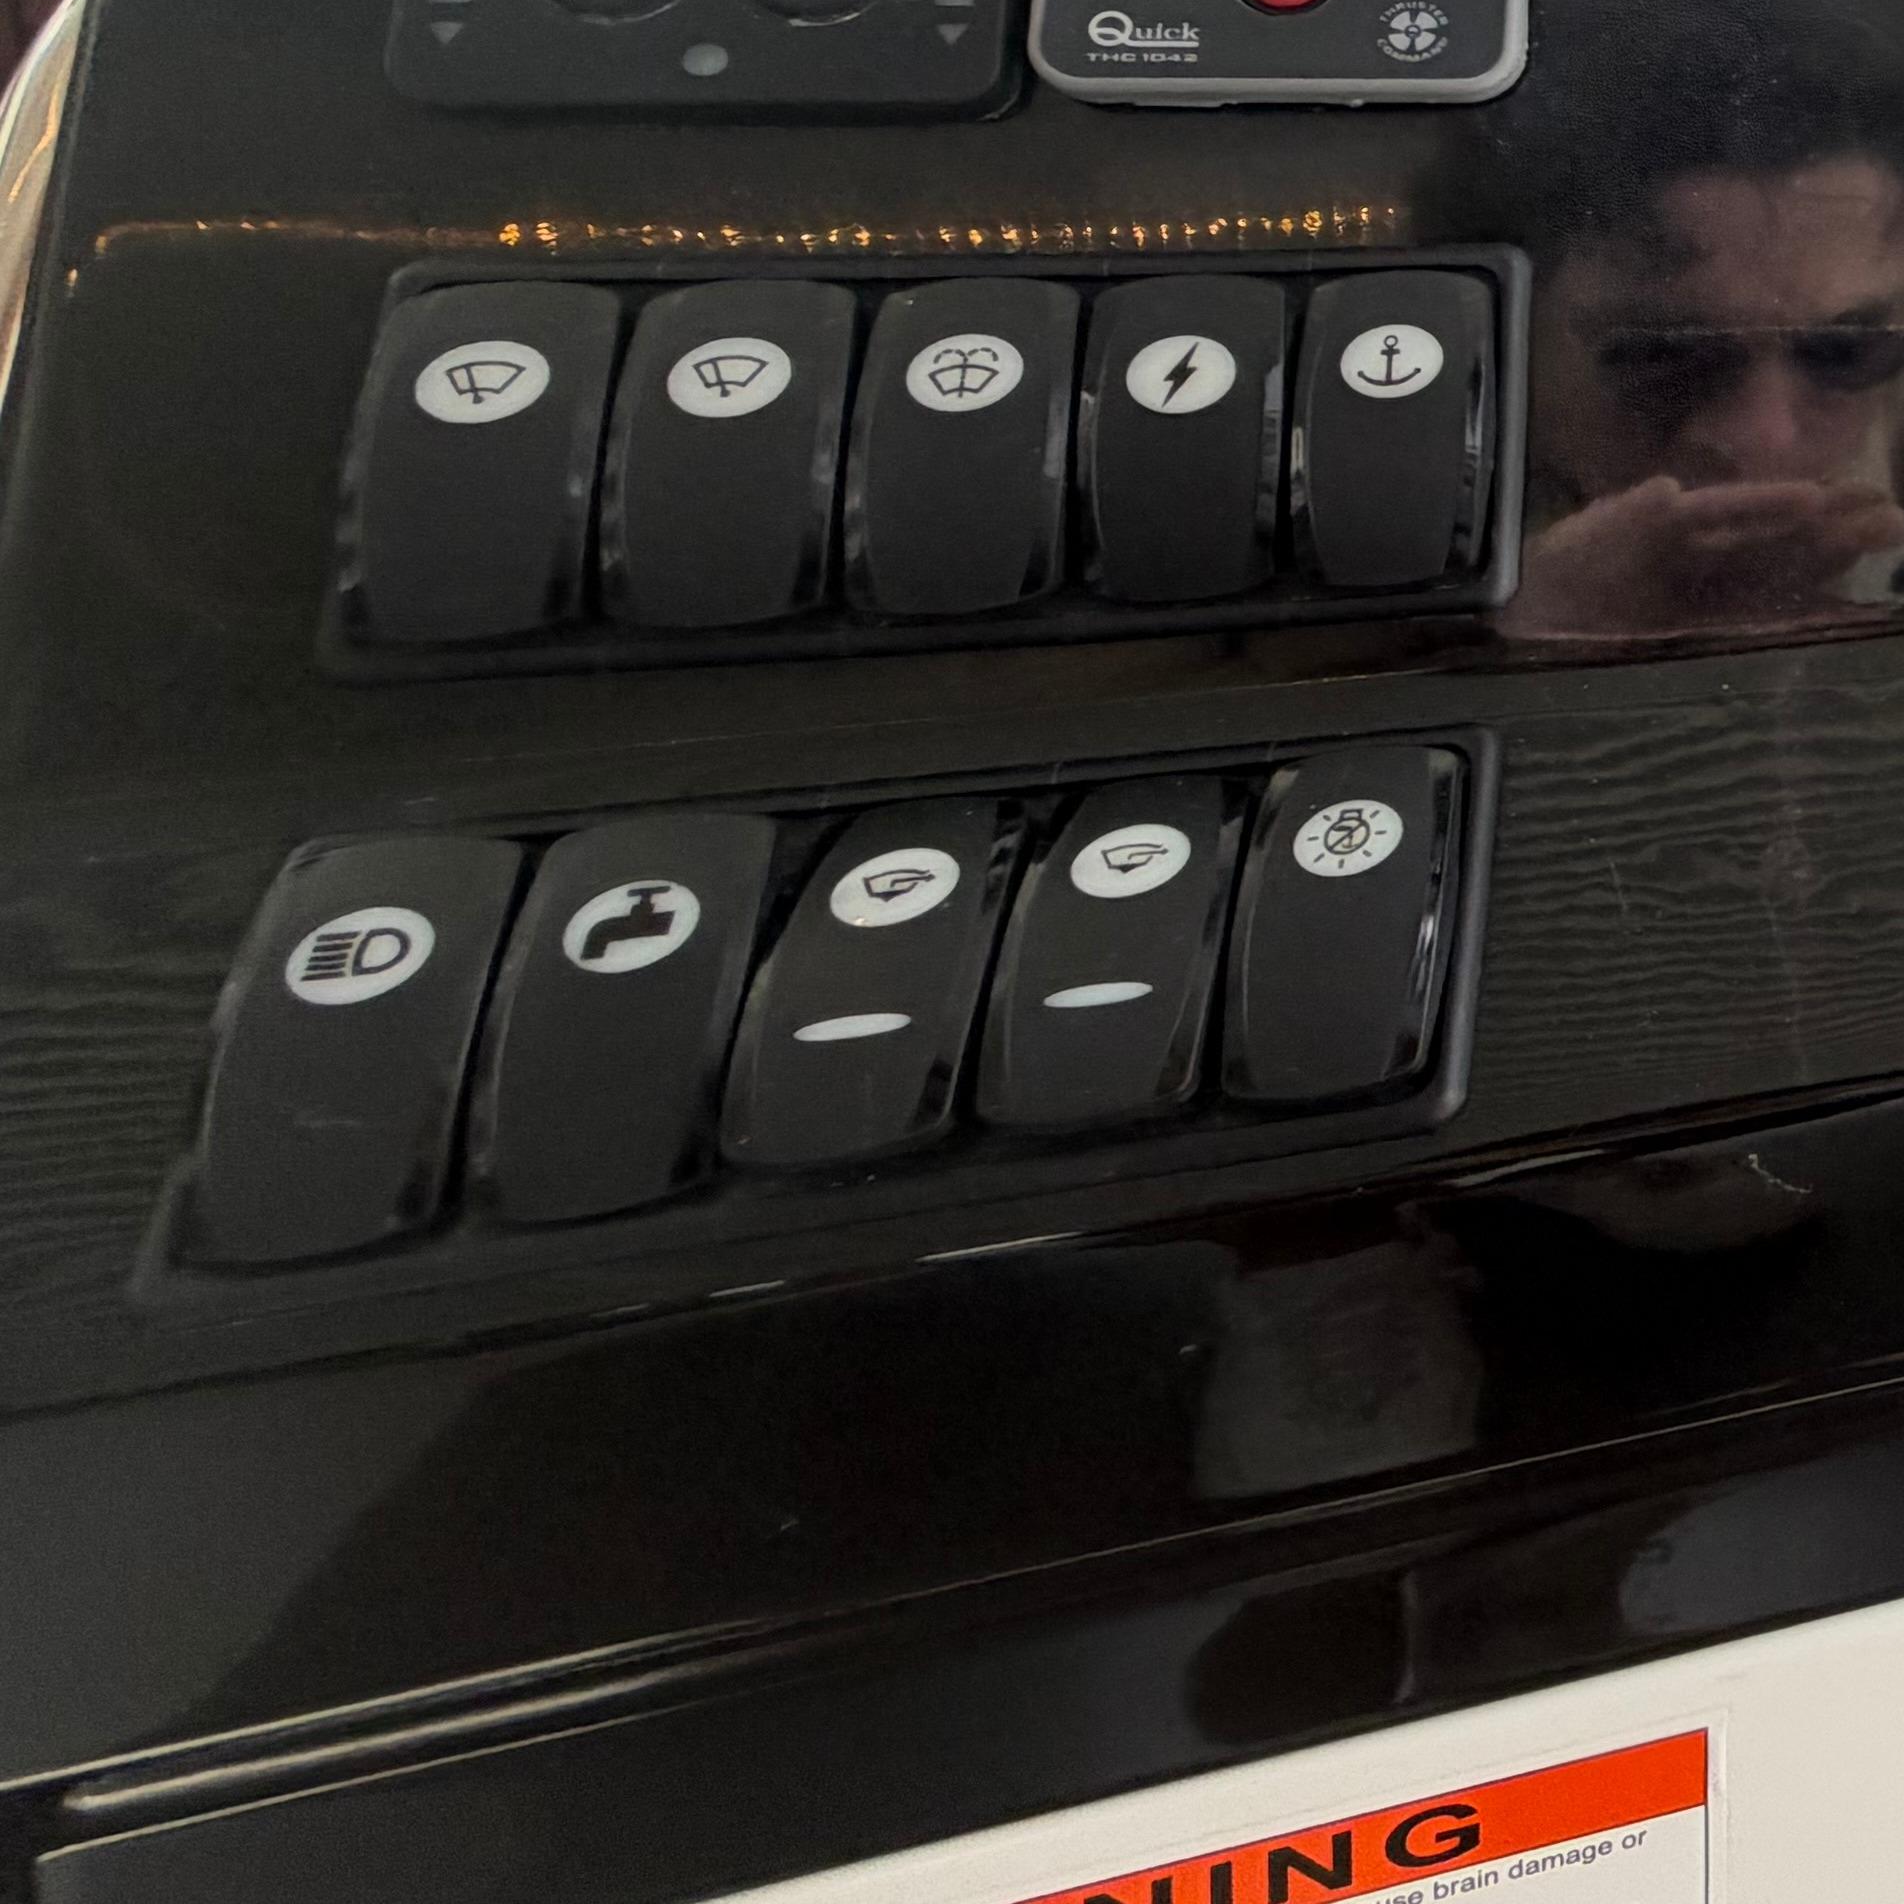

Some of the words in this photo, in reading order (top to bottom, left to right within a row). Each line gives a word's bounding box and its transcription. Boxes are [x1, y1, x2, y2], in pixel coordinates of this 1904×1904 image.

[1088, 10, 1200, 47] Quick
[1433, 1869, 1499, 1901] brain
[1507, 1836, 1612, 1881] damage
[1621, 1830, 1648, 1851] or
